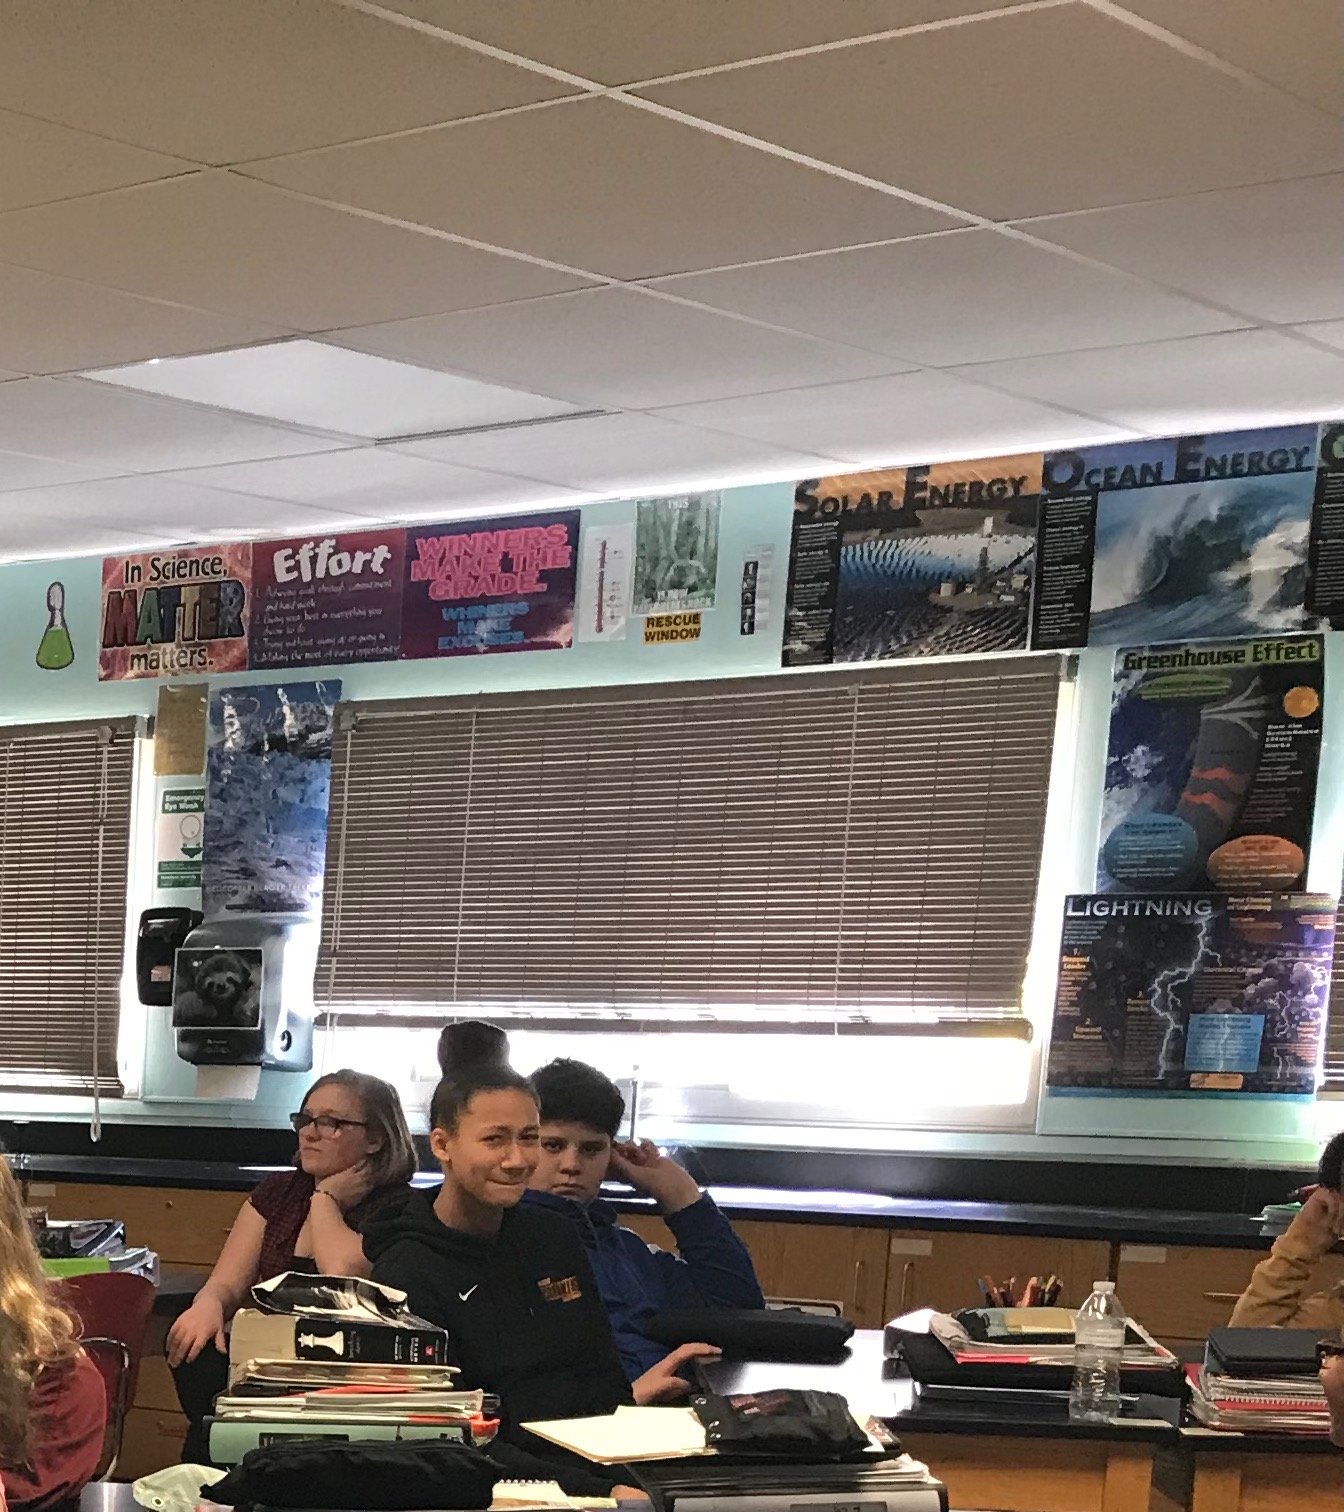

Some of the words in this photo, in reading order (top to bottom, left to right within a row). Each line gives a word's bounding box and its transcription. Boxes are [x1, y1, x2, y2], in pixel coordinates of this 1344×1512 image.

[1042, 450, 1163, 494] OCEAN
[1174, 436, 1311, 481] ENERGY
[794, 478, 895, 518] SOLAR
[903, 464, 1029, 510] ENERGY
[415, 524, 569, 562] WINNERS
[125, 560, 142, 584] In
[149, 555, 228, 581] Science,
[273, 539, 392, 583] Effort
[411, 552, 502, 582] MAKE
[510, 545, 573, 572] THE
[428, 570, 548, 601] GRADE.
[102, 579, 246, 648] MATTER
[646, 613, 701, 628] RESCUE
[644, 626, 702, 643] WINDOW
[130, 647, 214, 671] matters.
[1123, 648, 1246, 671] Greenhouse
[1252, 641, 1318, 663] Effect
[1066, 898, 1213, 917] LIGHTNING
